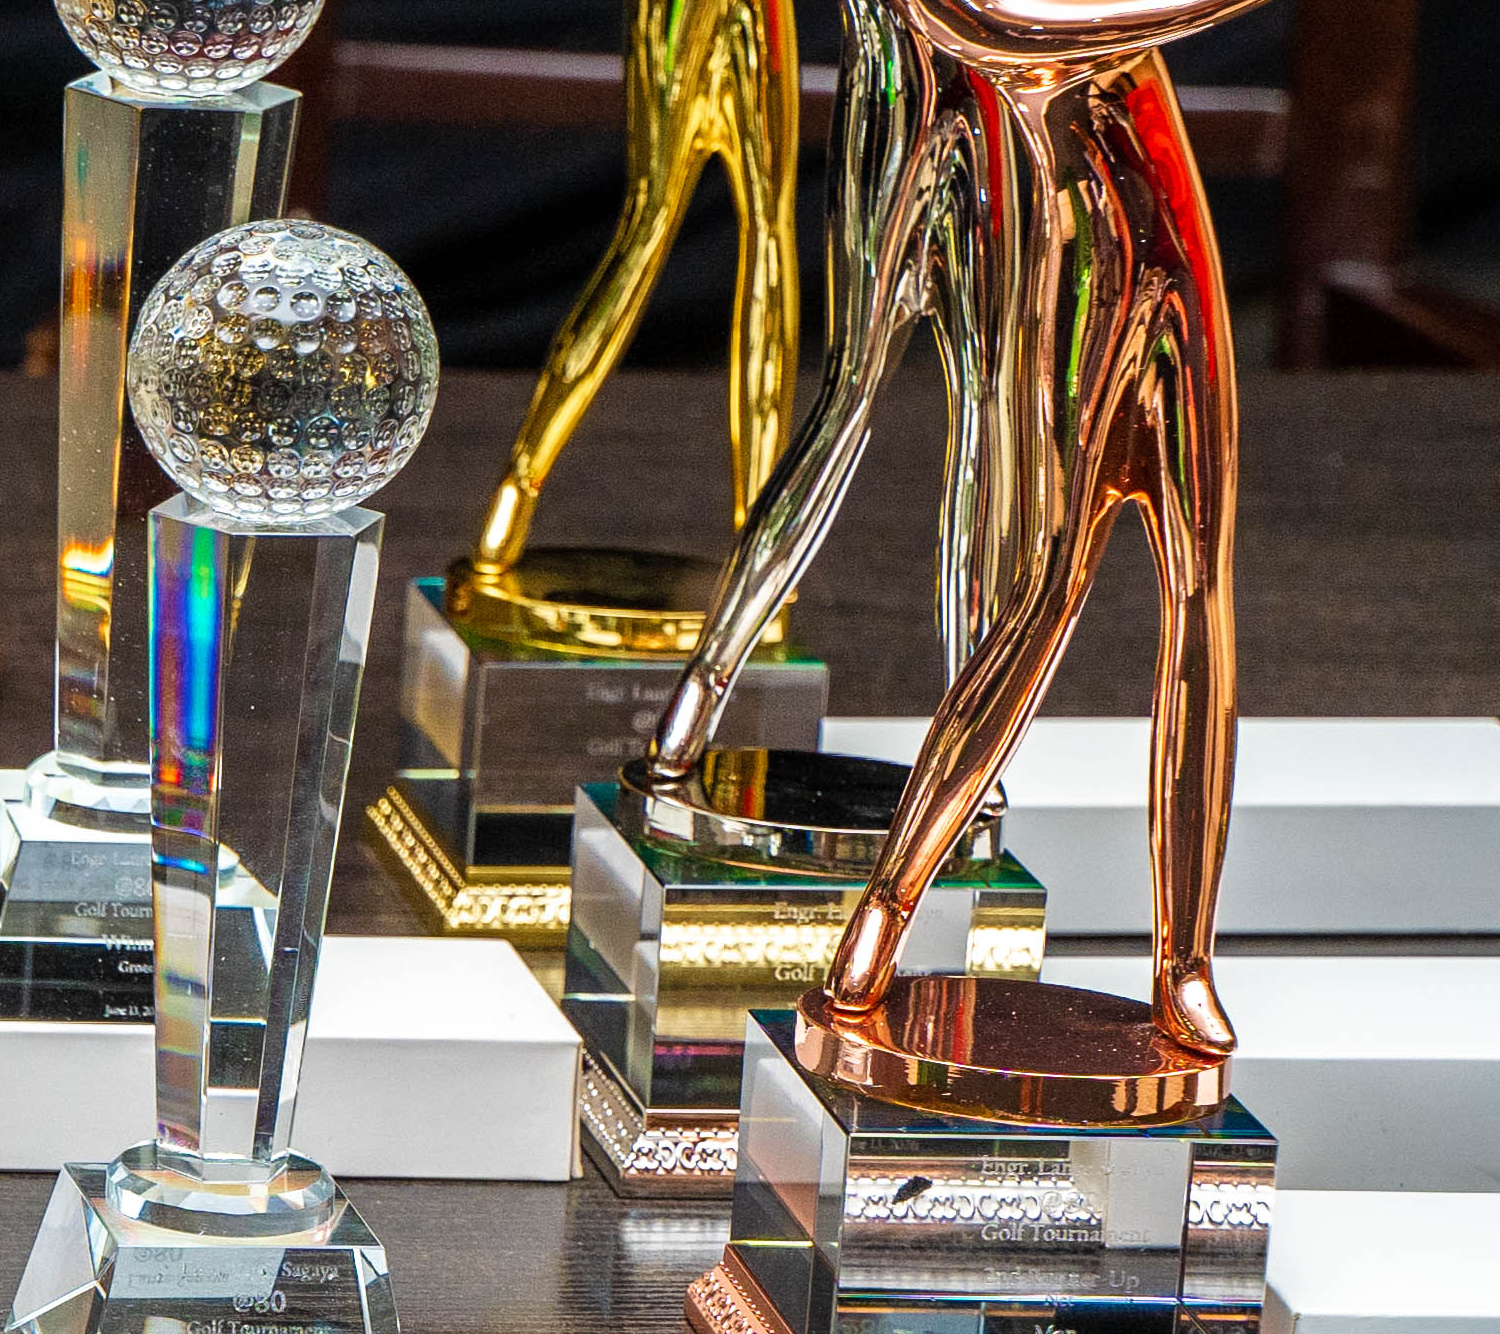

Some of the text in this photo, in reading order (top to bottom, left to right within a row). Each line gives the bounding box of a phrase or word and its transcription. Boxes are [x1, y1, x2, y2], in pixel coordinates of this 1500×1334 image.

[774, 962, 818, 982] Golf
[981, 1156, 1031, 1180] Engr.
[981, 1222, 1024, 1242] Golf
[280, 1261, 340, 1284] Sagaya
[232, 1289, 287, 1313] @80
